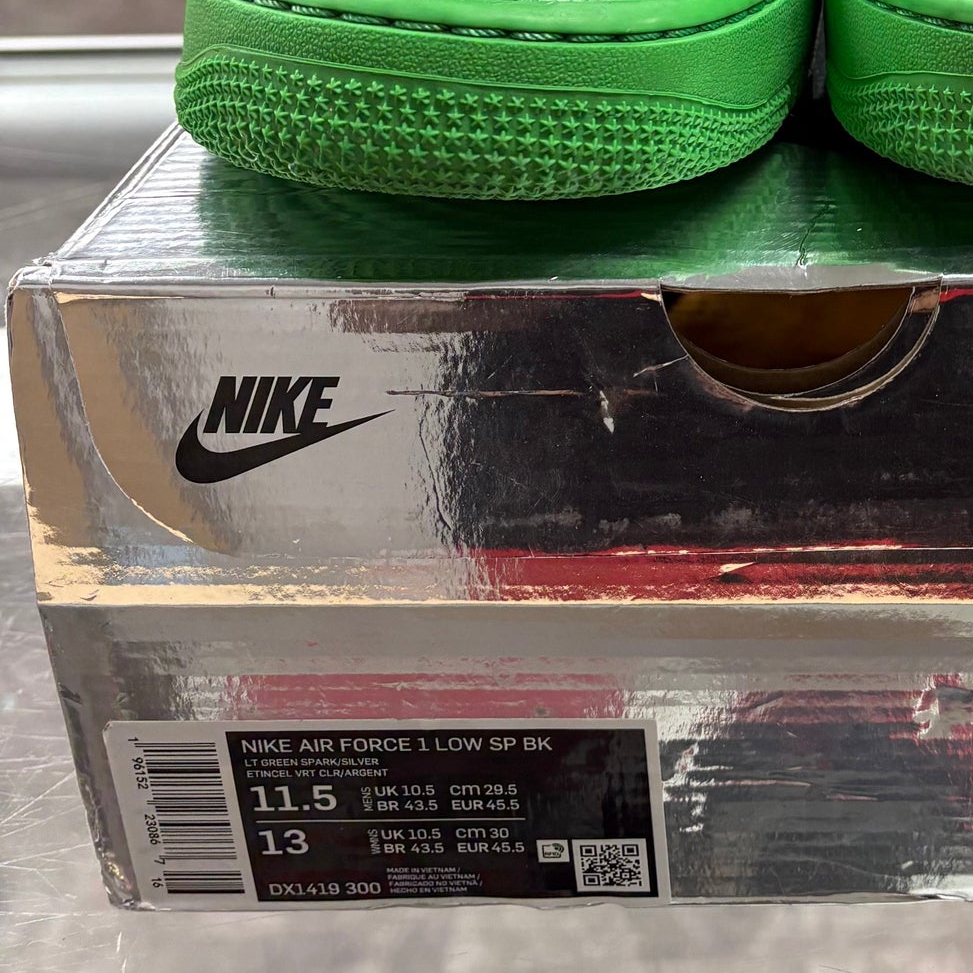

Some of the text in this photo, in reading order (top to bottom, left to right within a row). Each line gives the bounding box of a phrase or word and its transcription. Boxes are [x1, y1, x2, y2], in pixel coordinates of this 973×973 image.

[203, 376, 340, 433] NIKE
[241, 736, 553, 753] NIKE AIR FORCE 1 LOW SP BK
[244, 757, 379, 767] LT GREEN SPARK/SILVER
[132, 757, 149, 790] 96152
[246, 768, 388, 778] ETINCEL VRT CLR/ARGENT
[375, 785, 399, 796] UK
[402, 785, 435, 796] 10.5
[484, 784, 518, 795] 29.5
[250, 785, 337, 811] 11.5
[360, 786, 374, 812] MENS
[377, 799, 520, 811] BR 43.5 EUR 45.5
[144, 814, 161, 845] 23086
[381, 829, 405, 840] UK
[408, 828, 441, 839] 10.5
[490, 828, 509, 839] 30
[258, 829, 309, 855] 13
[368, 828, 381, 855] WMNS
[383, 842, 525, 854] BR 43.5 EUR 45.5
[151, 877, 163, 888] 16
[268, 882, 381, 895] DX1419 300
